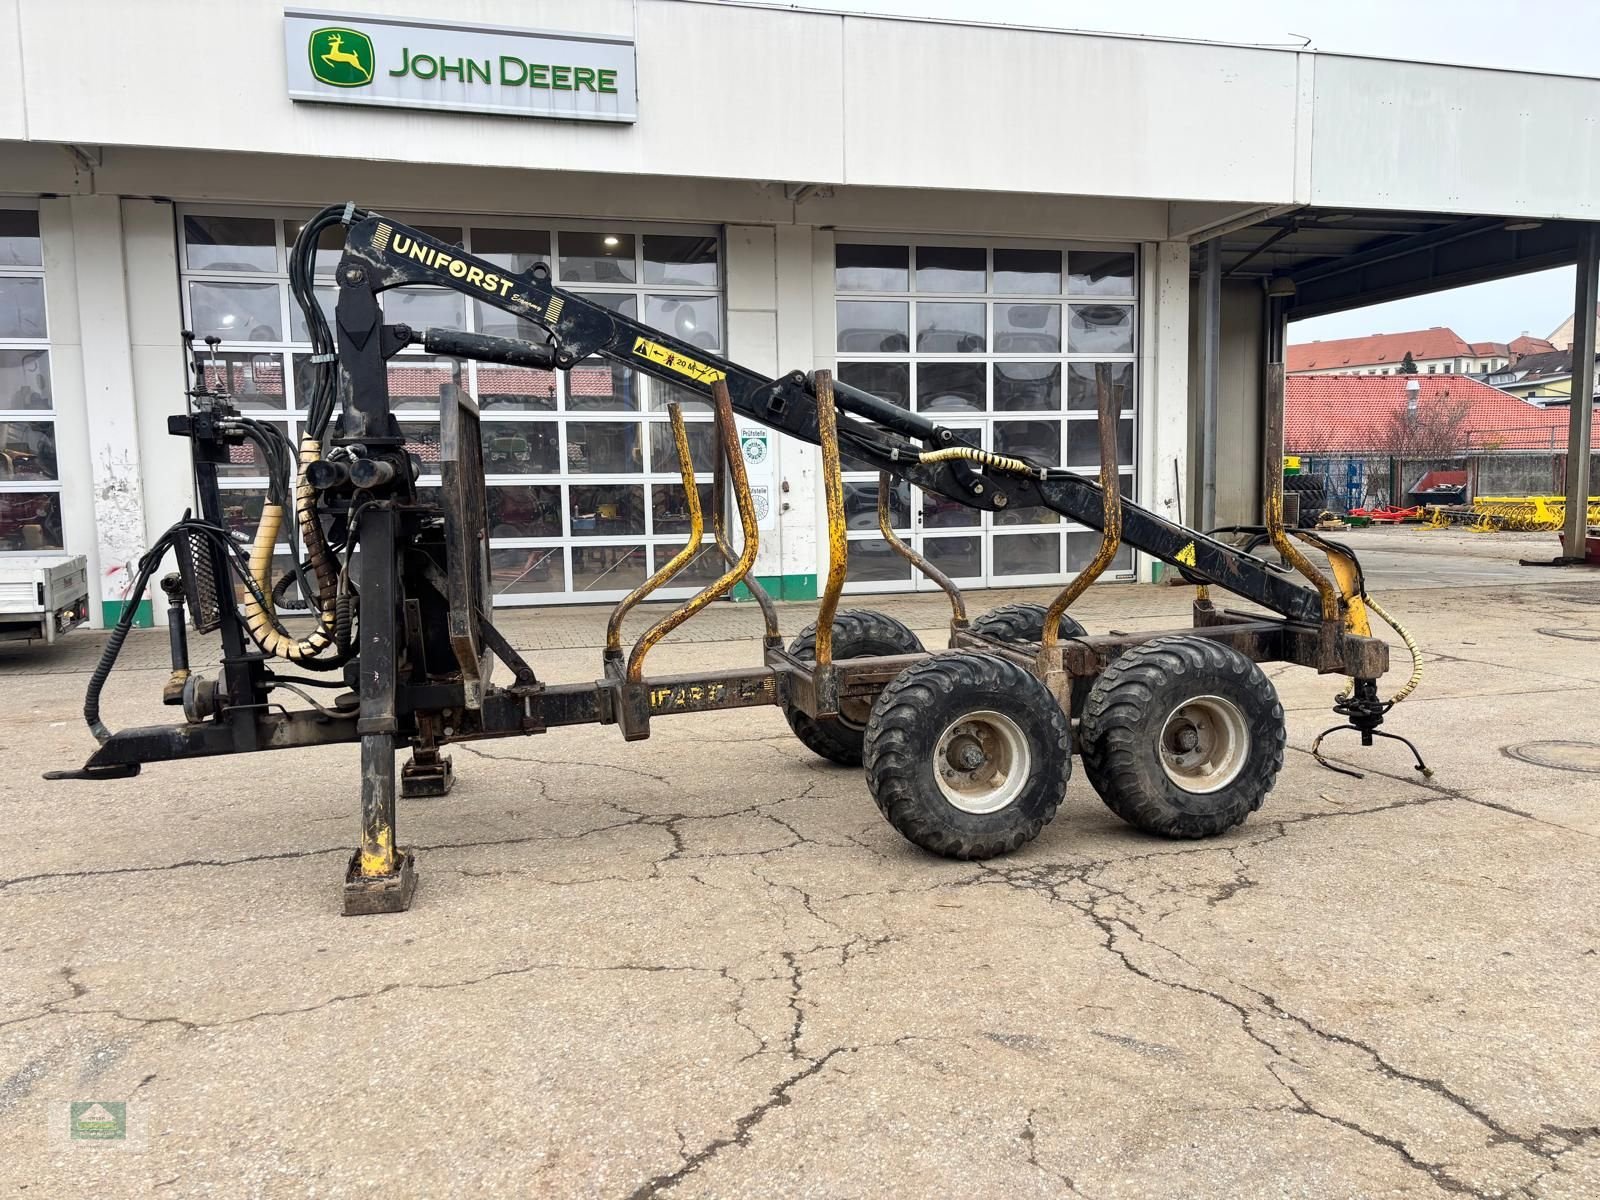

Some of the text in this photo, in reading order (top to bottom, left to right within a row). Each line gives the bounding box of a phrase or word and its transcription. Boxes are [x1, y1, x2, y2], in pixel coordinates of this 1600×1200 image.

[389, 47, 618, 94] JOHN DEERE
[392, 233, 514, 297] UNIFORST
[676, 358, 687, 368] 20
[750, 487, 767, 495] fstelle
